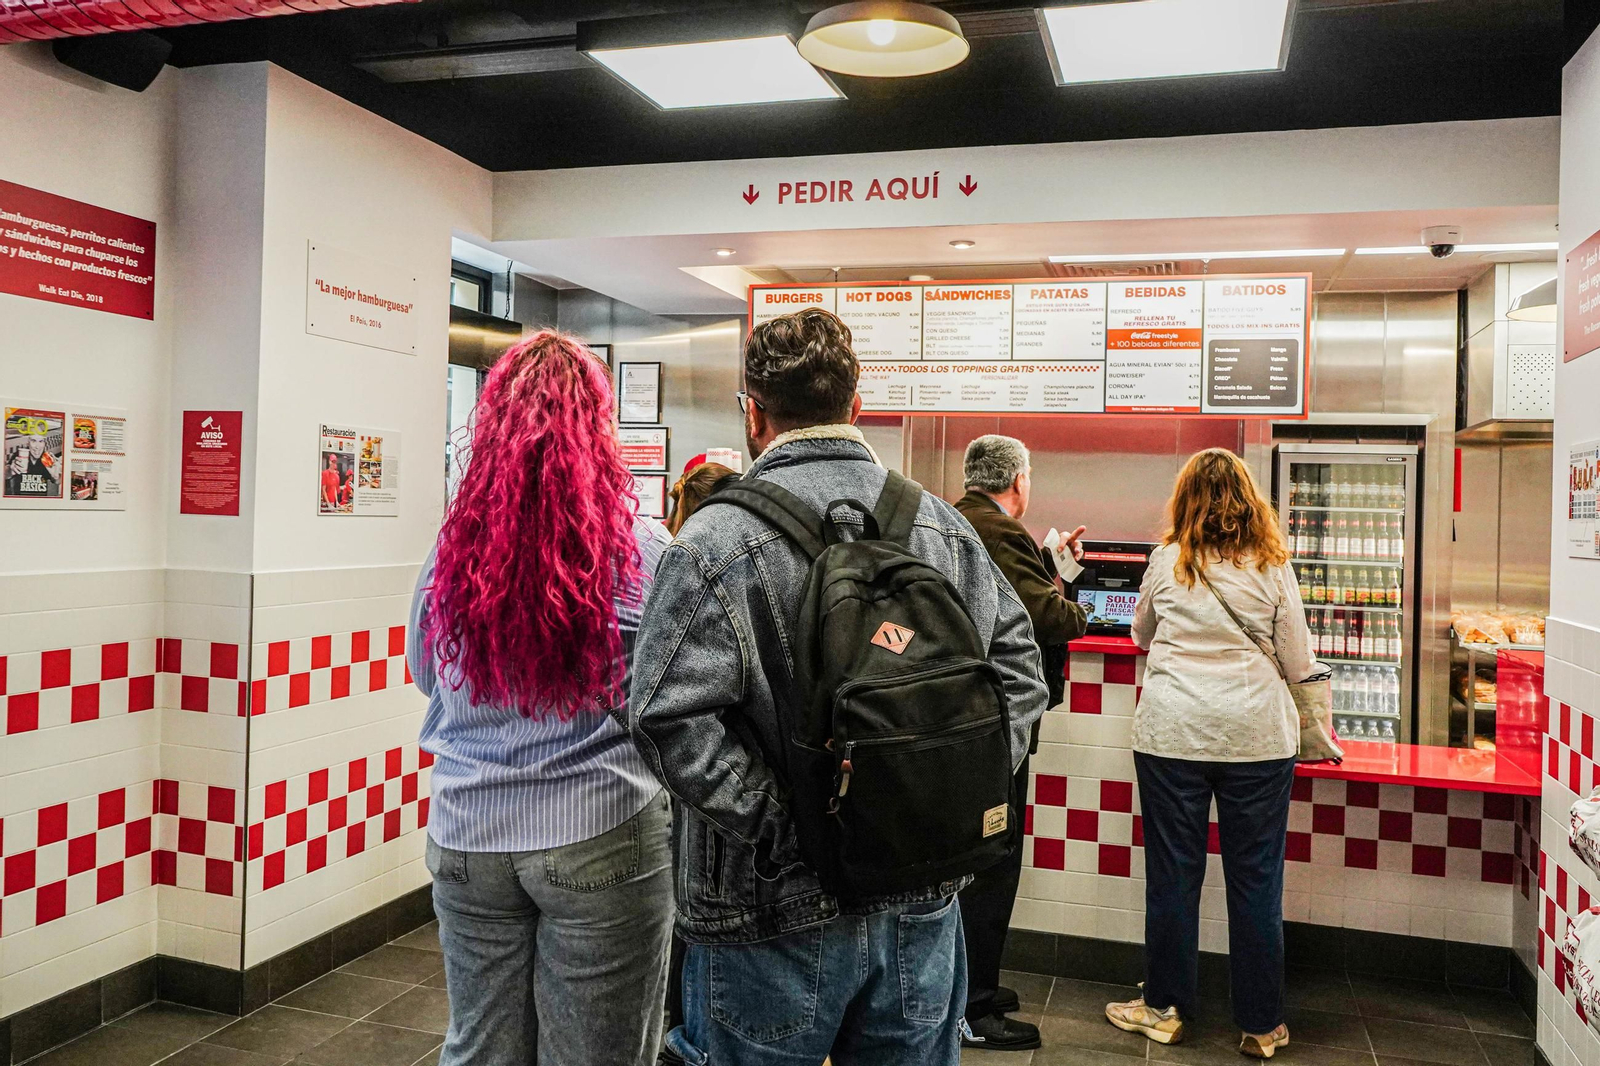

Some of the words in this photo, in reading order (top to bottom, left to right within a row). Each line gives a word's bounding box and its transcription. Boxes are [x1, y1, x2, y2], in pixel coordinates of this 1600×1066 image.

[778, 180, 854, 204] PEDIR
[865, 171, 940, 201] AQUÍ
[0, 208, 68, 236] amburguesas,
[70, 229, 106, 244] perritos
[108, 237, 145, 254] calientes
[5, 228, 61, 250] sándwiches
[63, 242, 84, 256] para
[85, 246, 124, 266] chuparse
[126, 254, 138, 268] los
[10, 247, 18, 258] y
[18, 246, 53, 264] hechos
[54, 256, 71, 269] con
[72, 260, 117, 278] productos
[38, 283, 56, 294] Walk
[58, 288, 70, 298] Eat
[86, 294, 104, 304] 2018
[332, 286, 356, 300] mejor
[925, 288, 1011, 302] SÁNDWICHES
[1030, 288, 1089, 300] PATATAS
[1125, 286, 1186, 298] BEBIDAS
[1222, 284, 1286, 296] BATIDOS
[766, 293, 823, 304] BURGERS
[846, 292, 872, 302] HOT
[876, 292, 912, 302] DOGS
[369, 320, 382, 328] 2016
[322, 425, 356, 437] Restauración
[22, 474, 42, 483] BACK
[20, 482, 47, 492] BASICS
[1106, 595, 1136, 604] SOLO
